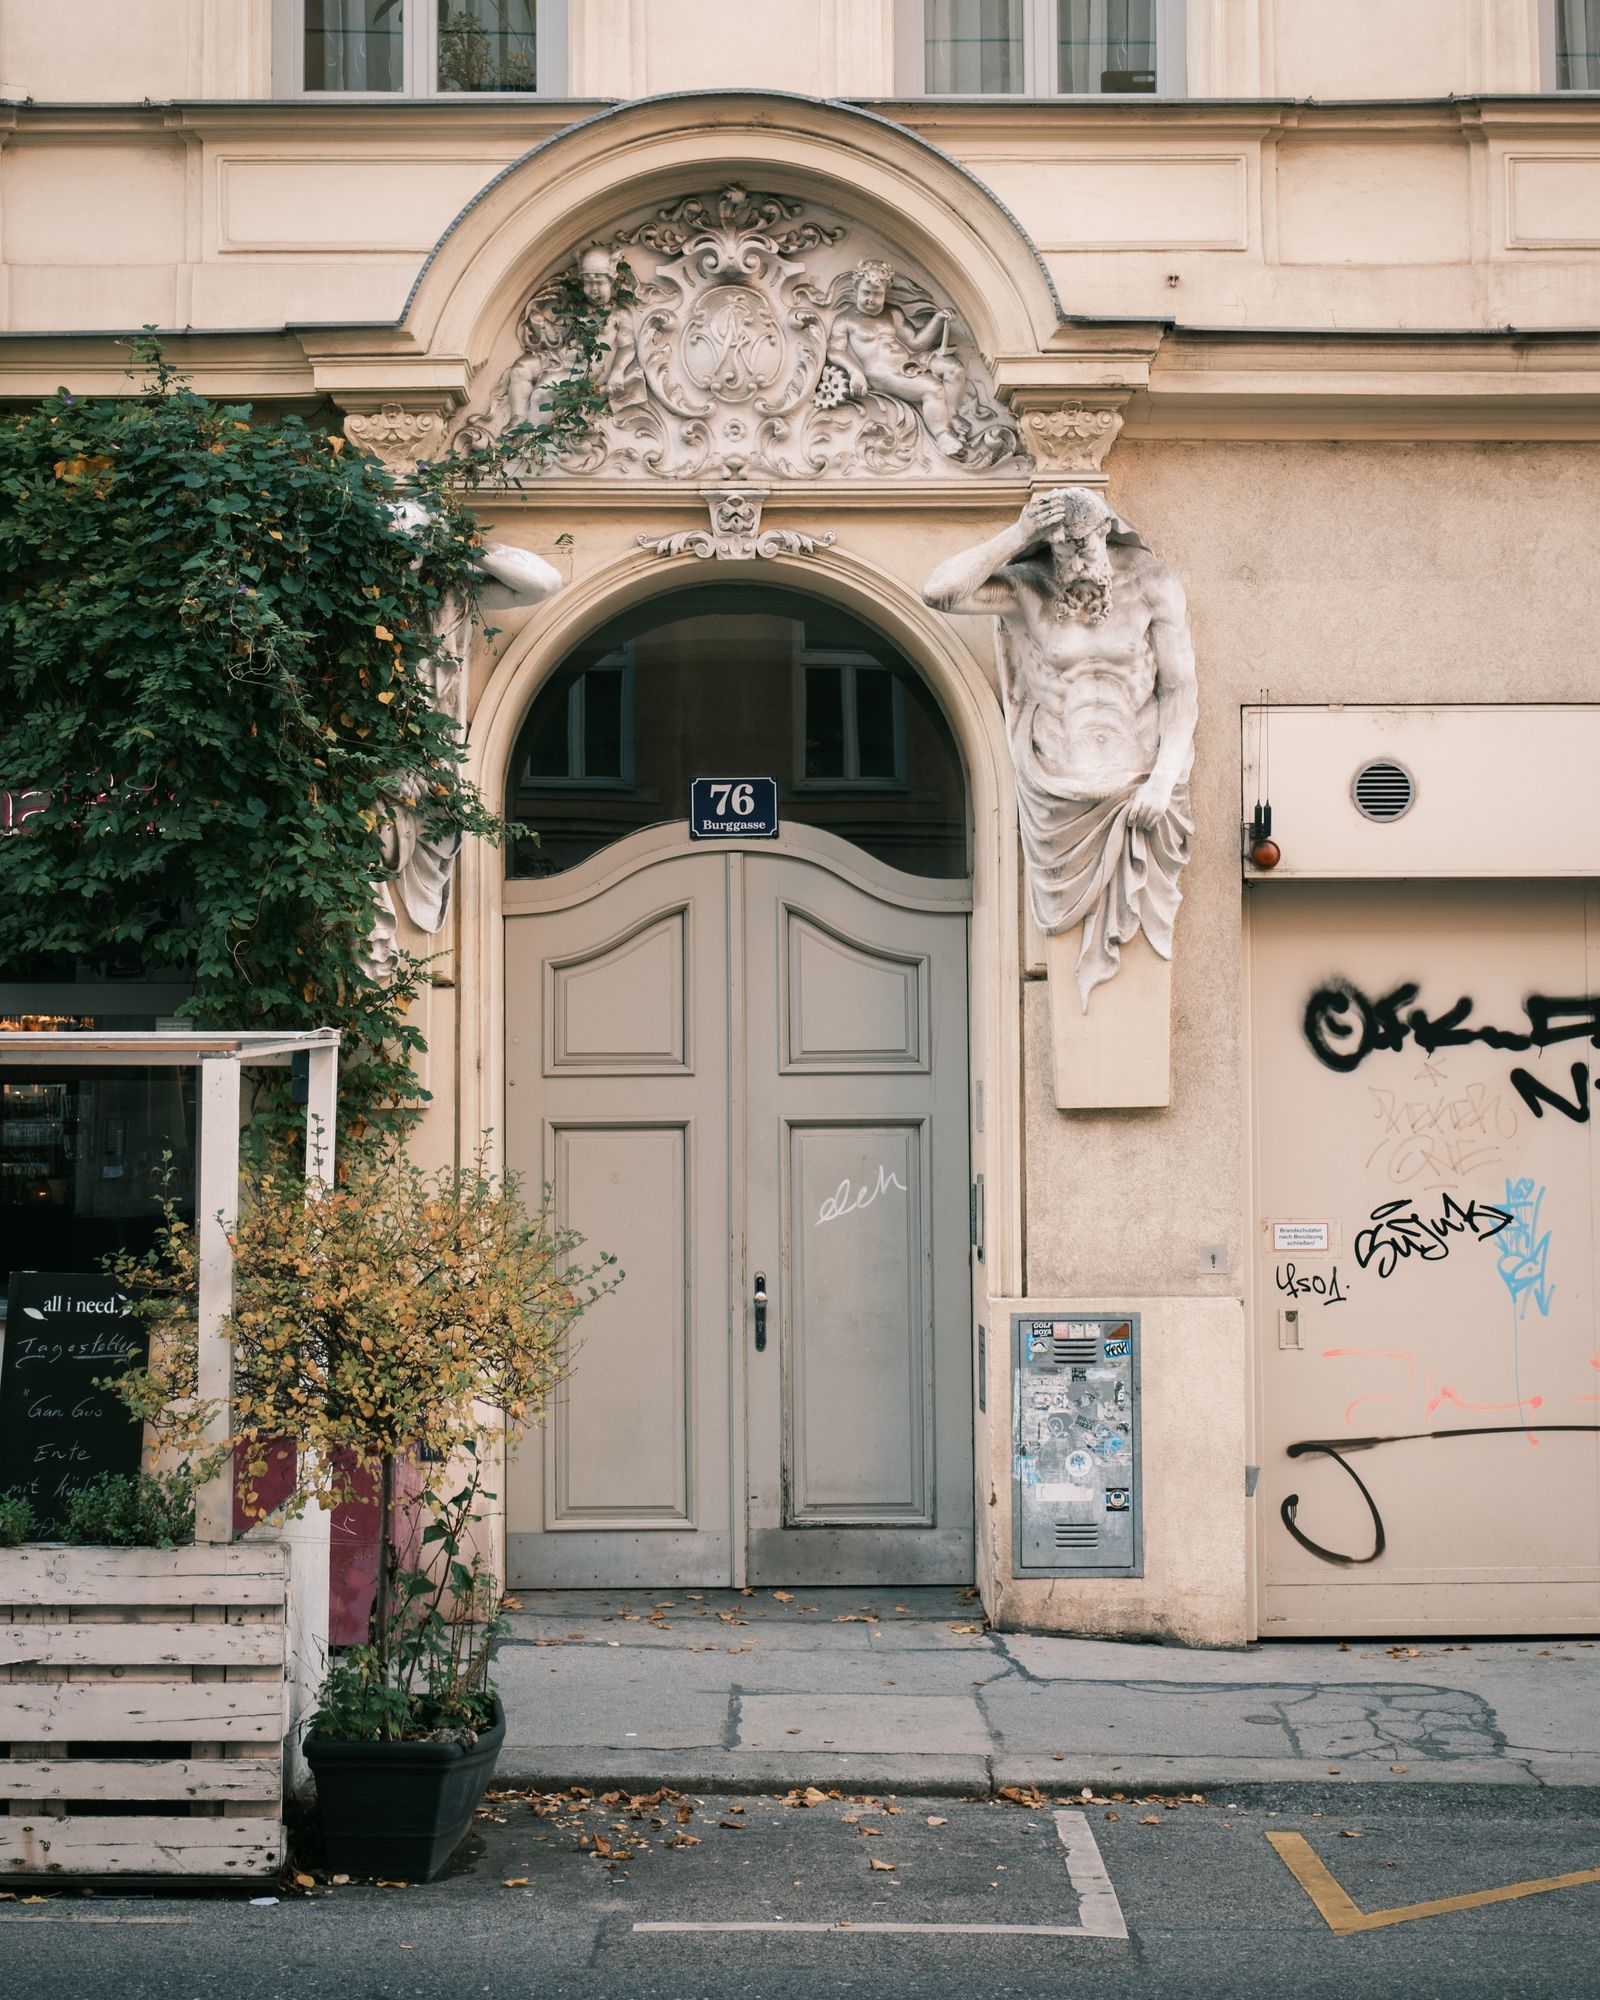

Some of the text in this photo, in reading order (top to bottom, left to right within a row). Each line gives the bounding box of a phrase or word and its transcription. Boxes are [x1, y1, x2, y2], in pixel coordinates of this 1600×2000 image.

[710, 784, 755, 816] 76
[703, 820, 766, 832] Burggasse
[43, 1296, 119, 1314] all i need.
[34, 1440, 91, 1462] Ente
